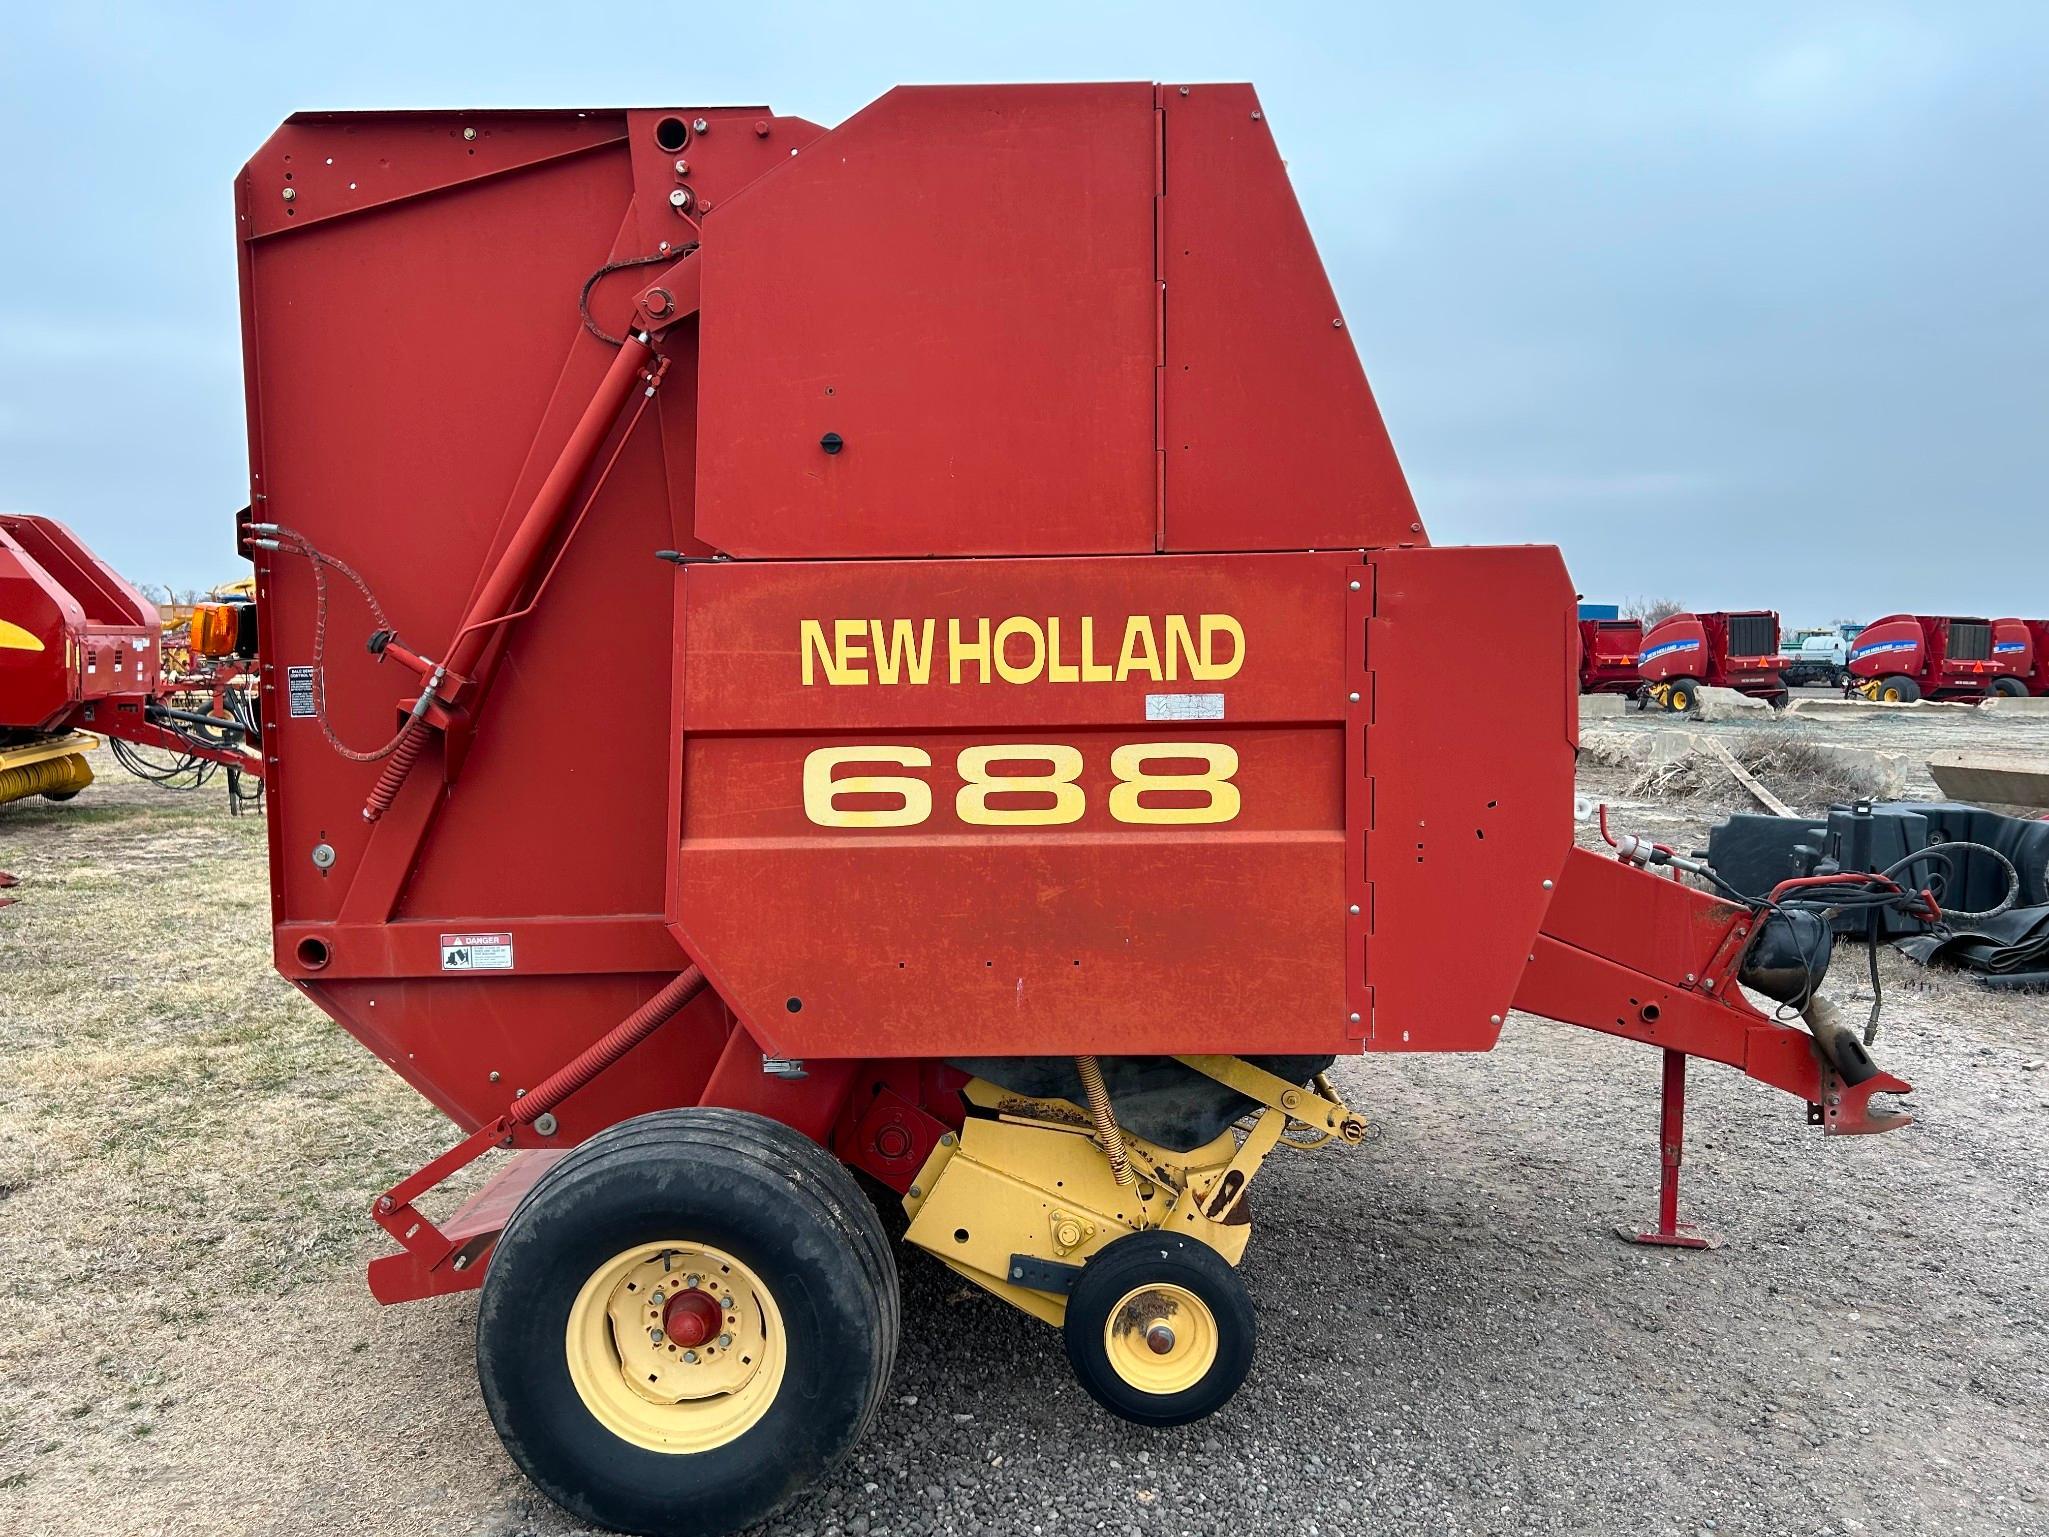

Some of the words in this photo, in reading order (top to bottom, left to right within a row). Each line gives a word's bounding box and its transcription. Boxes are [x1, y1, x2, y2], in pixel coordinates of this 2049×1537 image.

[801, 619, 935, 685] NEW
[949, 614, 1246, 684] HOLLAND
[803, 742, 1241, 828] 688
[465, 936, 500, 945] DANGER
